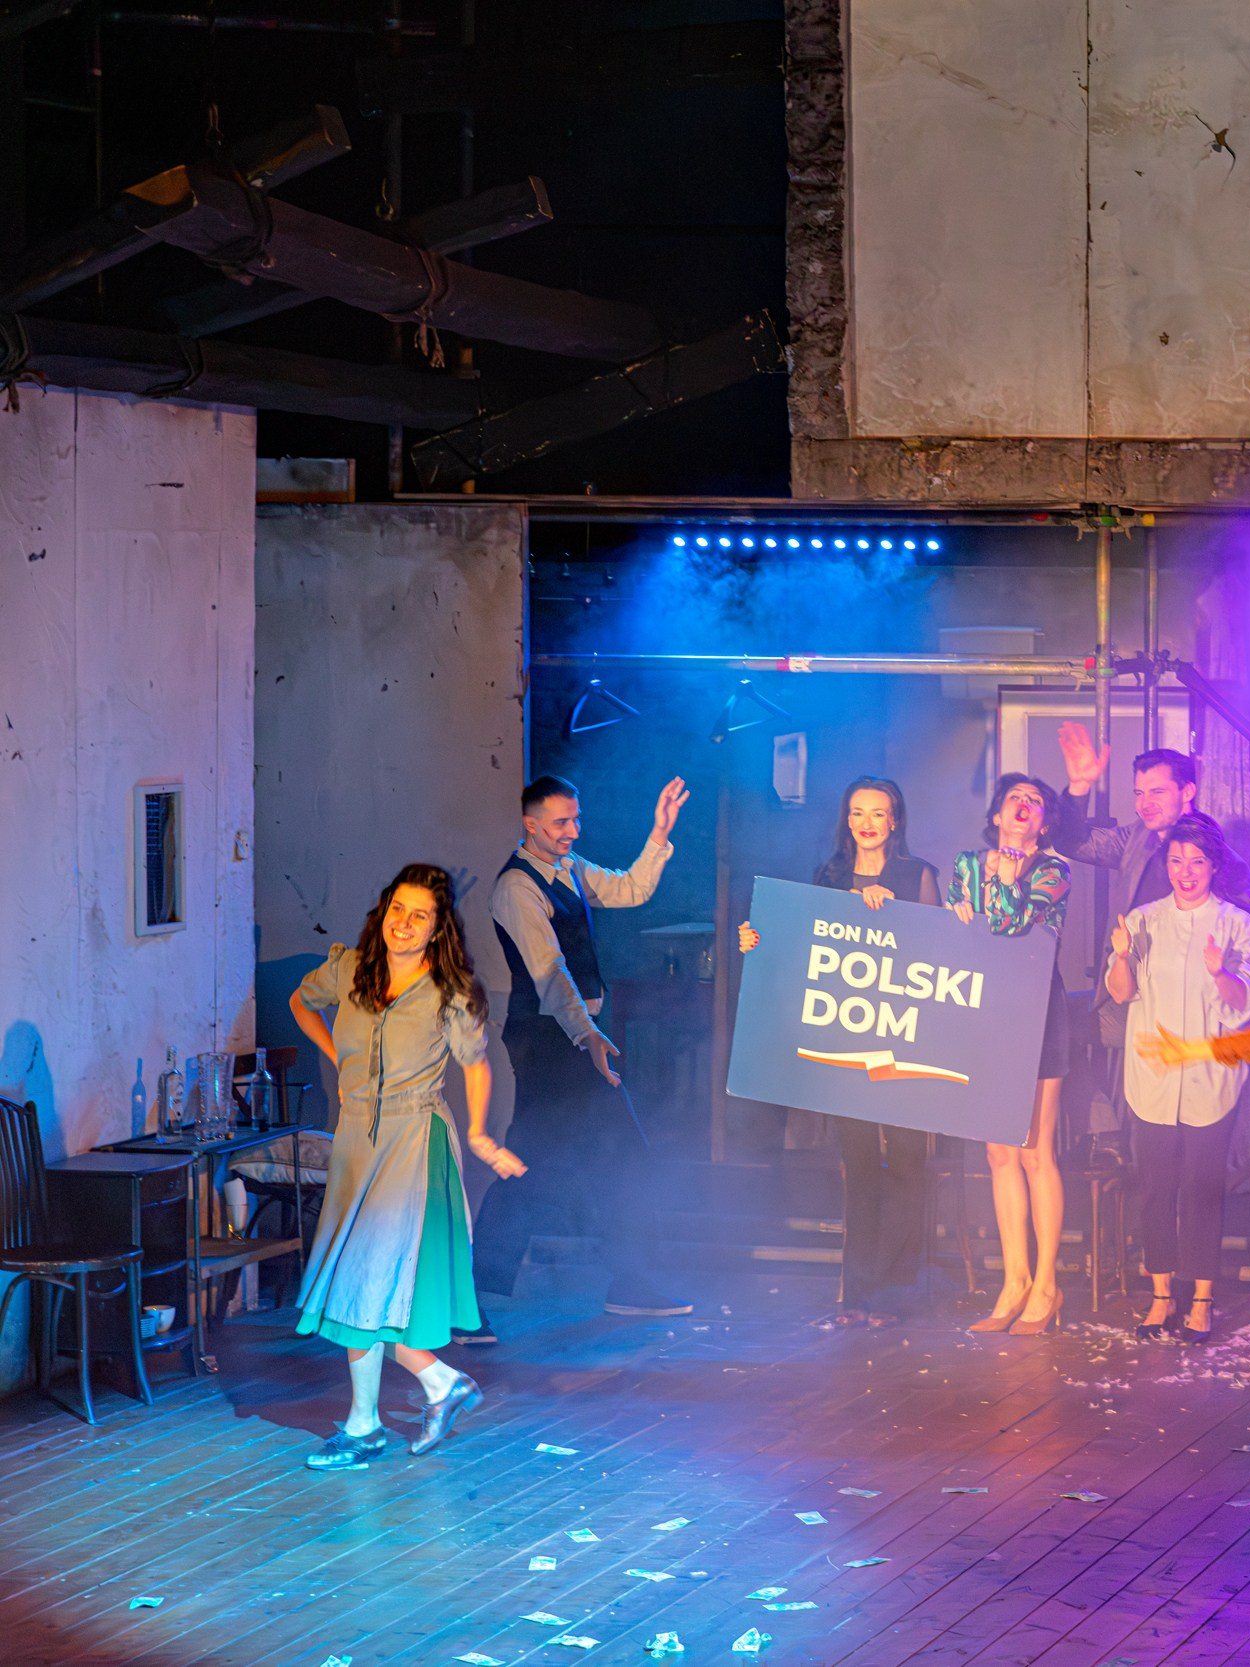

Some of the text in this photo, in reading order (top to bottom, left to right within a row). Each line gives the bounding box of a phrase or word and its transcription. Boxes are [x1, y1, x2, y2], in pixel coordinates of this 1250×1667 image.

[813, 919, 898, 950] BON NA
[807, 944, 985, 1009] POLSKI
[801, 988, 919, 1043] DOM
